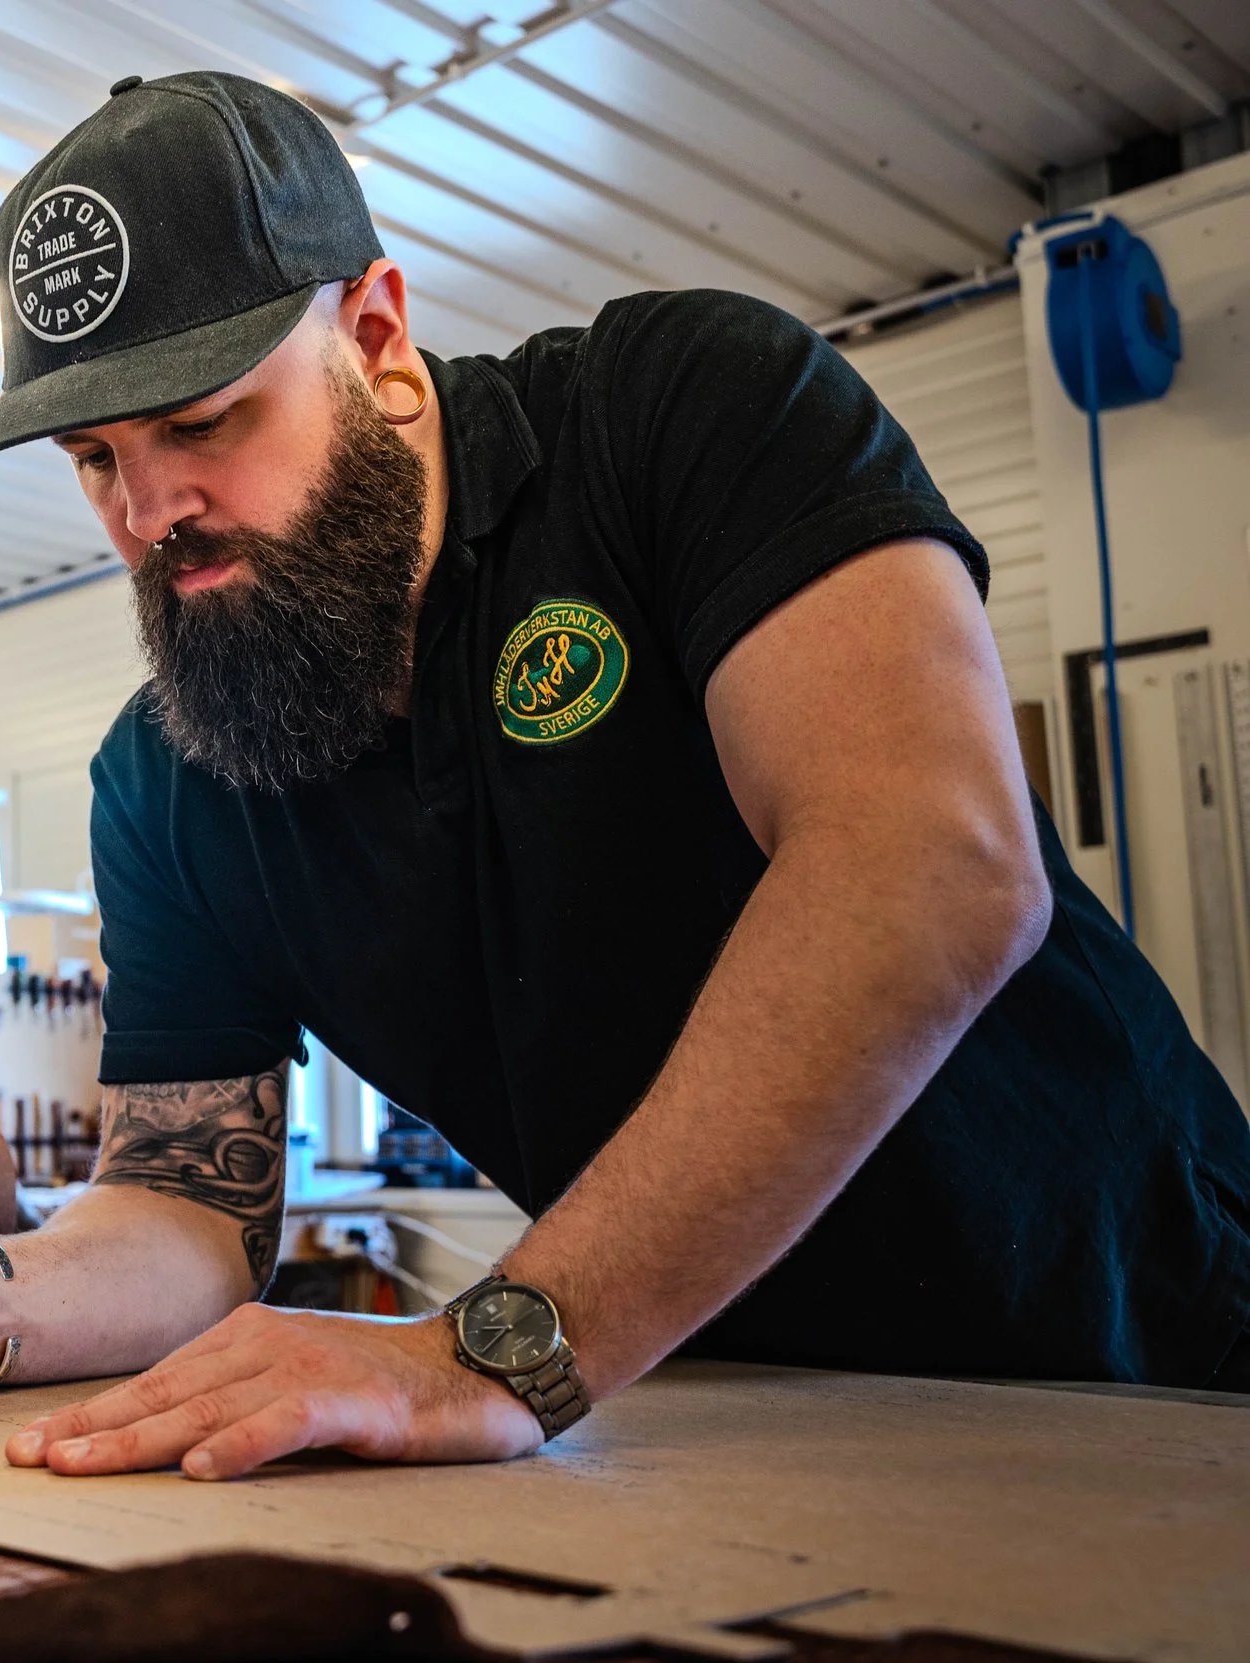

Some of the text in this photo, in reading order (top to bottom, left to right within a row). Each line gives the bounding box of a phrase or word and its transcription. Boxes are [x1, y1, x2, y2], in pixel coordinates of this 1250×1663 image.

[15, 197, 111, 270] BRIXTON
[37, 231, 77, 262] TRADE
[22, 264, 116, 331] SUPPLY
[44, 266, 82, 296] MARK
[589, 619, 612, 641] AB
[538, 694, 601, 737] SVERIGE
